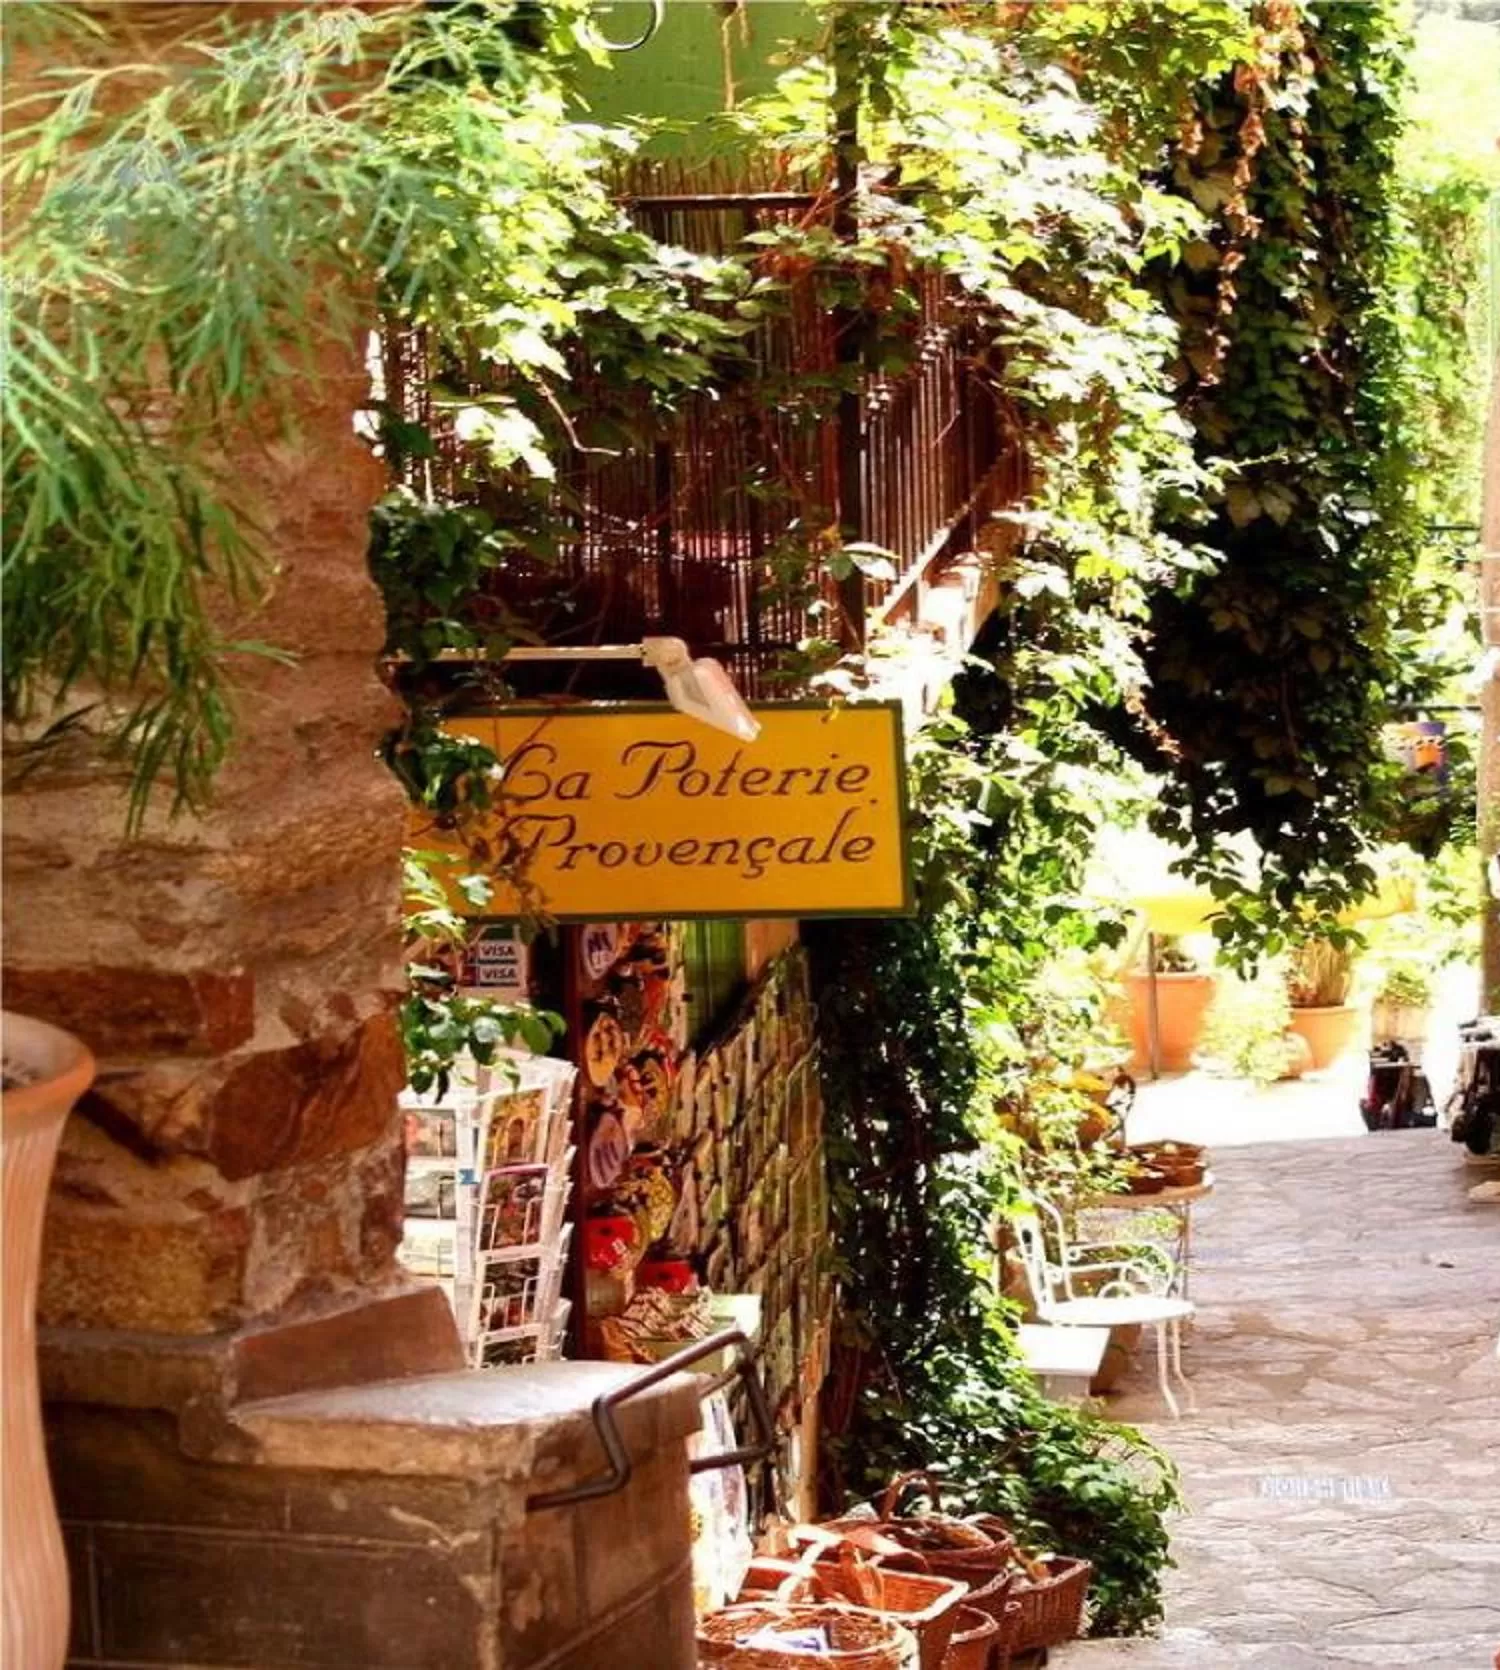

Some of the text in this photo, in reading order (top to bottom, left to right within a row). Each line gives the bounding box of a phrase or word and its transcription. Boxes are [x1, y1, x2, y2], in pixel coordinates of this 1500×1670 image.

[498, 740, 870, 801] La Poterie
[500, 805, 876, 879] Provençale
[481, 944, 515, 956] VISA
[482, 967, 517, 979] VISA
